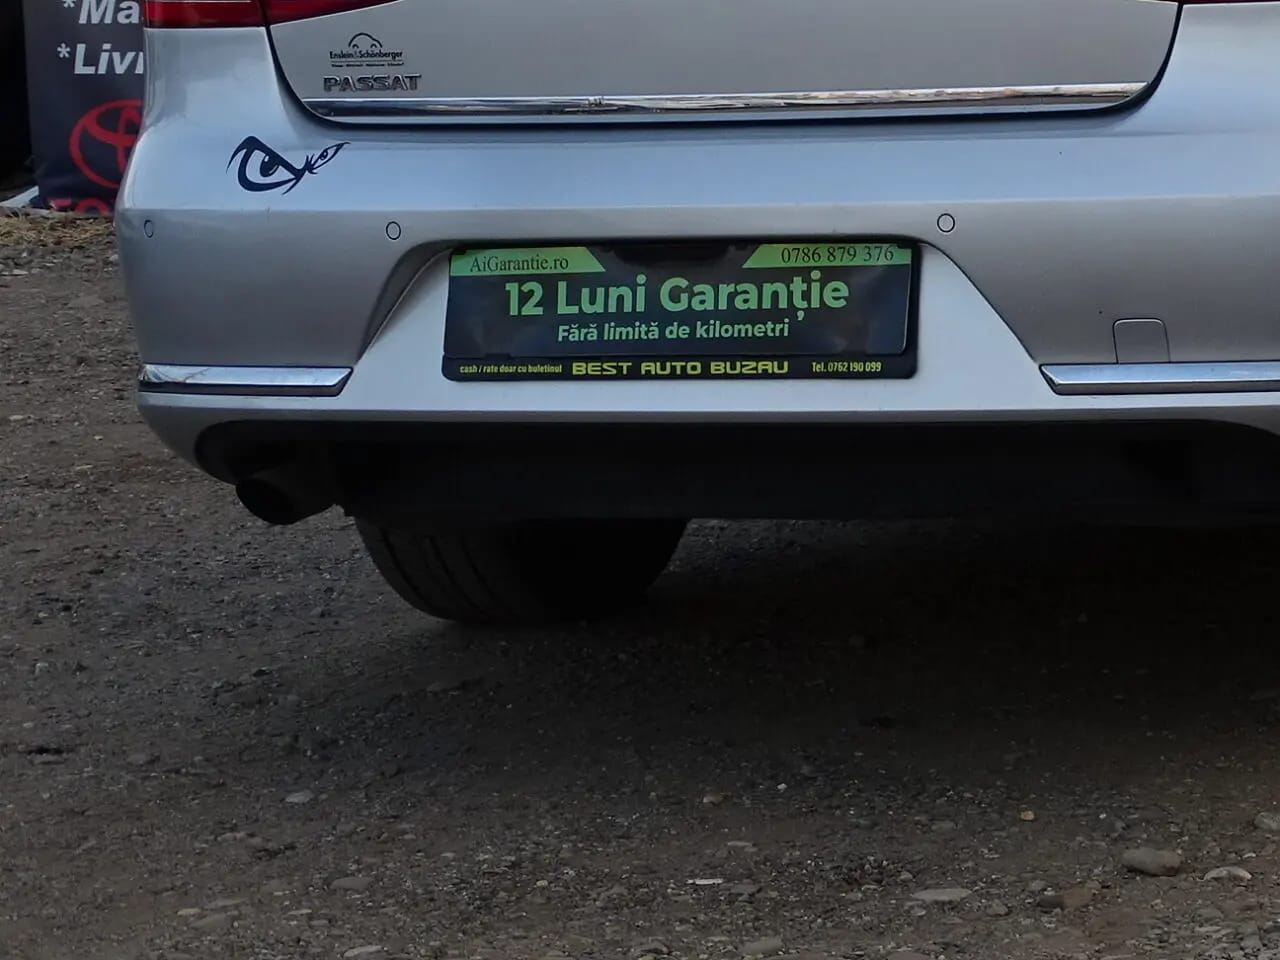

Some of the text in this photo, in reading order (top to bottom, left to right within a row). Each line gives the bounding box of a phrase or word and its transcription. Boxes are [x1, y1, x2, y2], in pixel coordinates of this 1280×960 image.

[323, 74, 422, 92] PASSAT
[469, 253, 569, 273] AiGarantie.ro
[780, 245, 894, 263] 0786 879 376
[505, 270, 850, 321] 12 Luni Garanție
[558, 319, 790, 341] Fără limită de kilometri
[459, 364, 478, 373] cash
[483, 364, 499, 373] rate
[499, 364, 517, 373] doar
[517, 365, 527, 373] cu
[571, 360, 790, 375] BEST AUTO BUZAU
[812, 361, 882, 372] Tel. 0762 190 099
